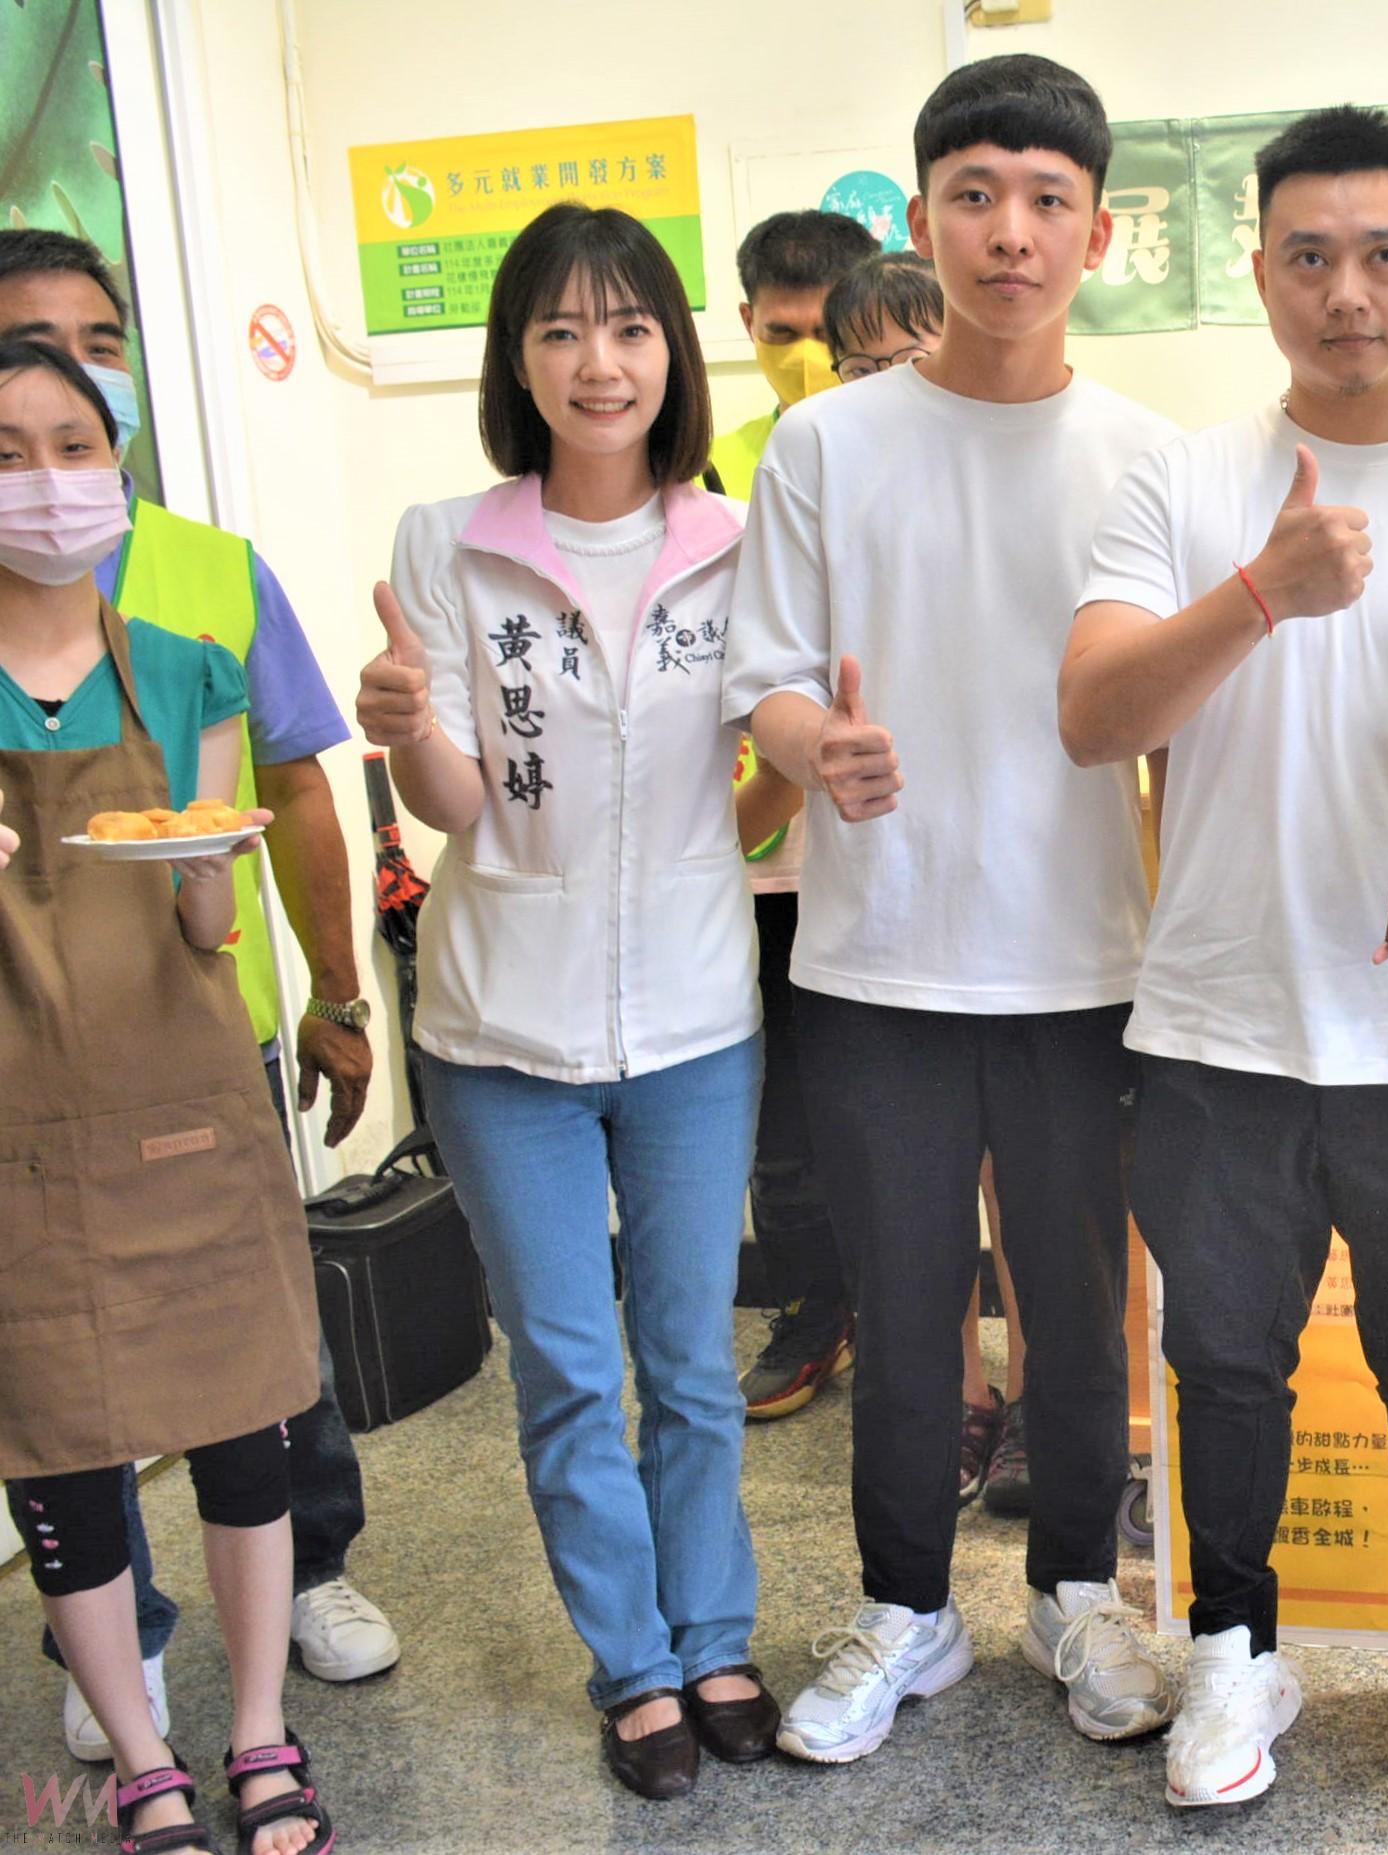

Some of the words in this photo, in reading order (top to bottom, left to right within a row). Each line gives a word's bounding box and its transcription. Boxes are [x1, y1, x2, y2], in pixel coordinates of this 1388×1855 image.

[446, 152, 668, 197] 多元就業開發方案
[556, 610, 589, 681] 議員
[488, 614, 554, 811] 黃思婷
[1292, 1431, 1387, 1450] 的甜點力量
[1290, 1457, 1370, 1476] 步成長…
